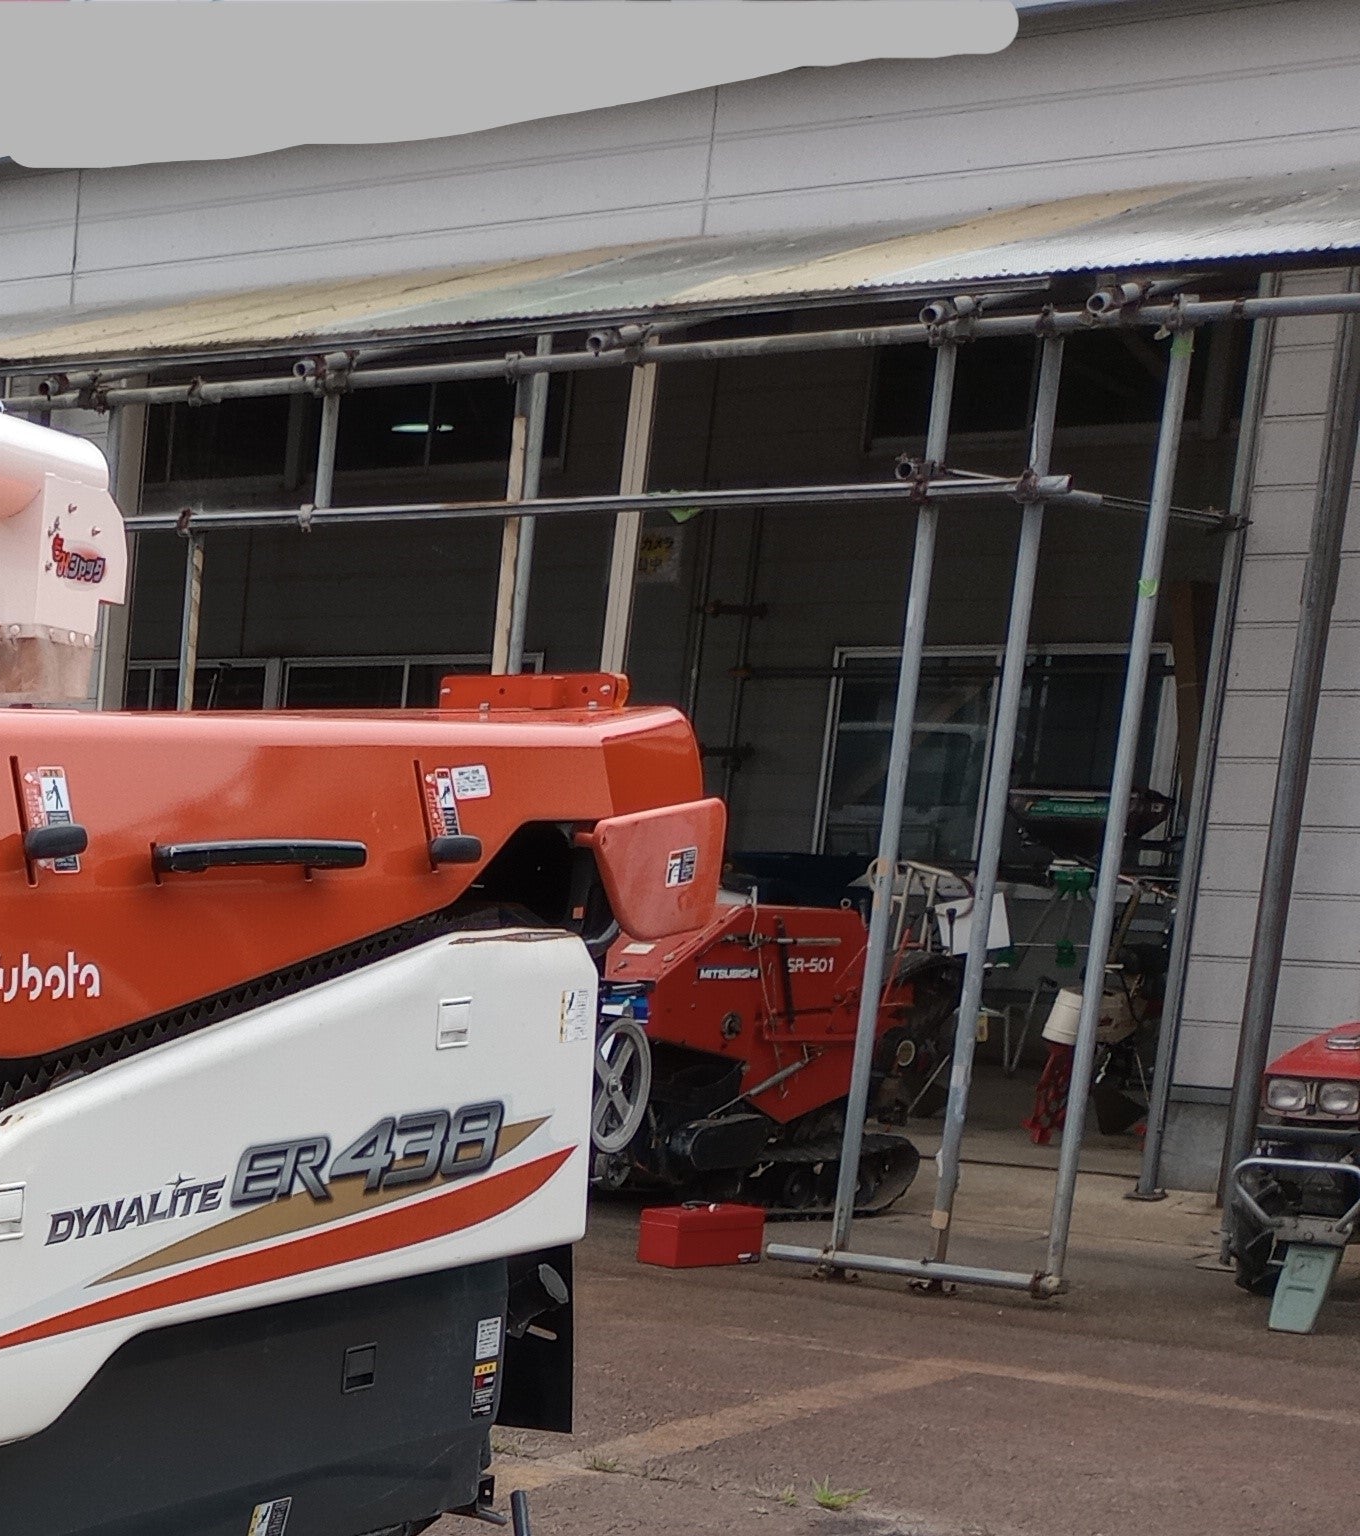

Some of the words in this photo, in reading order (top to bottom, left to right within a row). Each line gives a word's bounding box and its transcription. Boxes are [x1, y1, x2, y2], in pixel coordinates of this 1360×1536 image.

[699, 967, 759, 980] MITSUBISHI
[787, 956, 835, 974] SR-501
[229, 1099, 505, 1208] ER438
